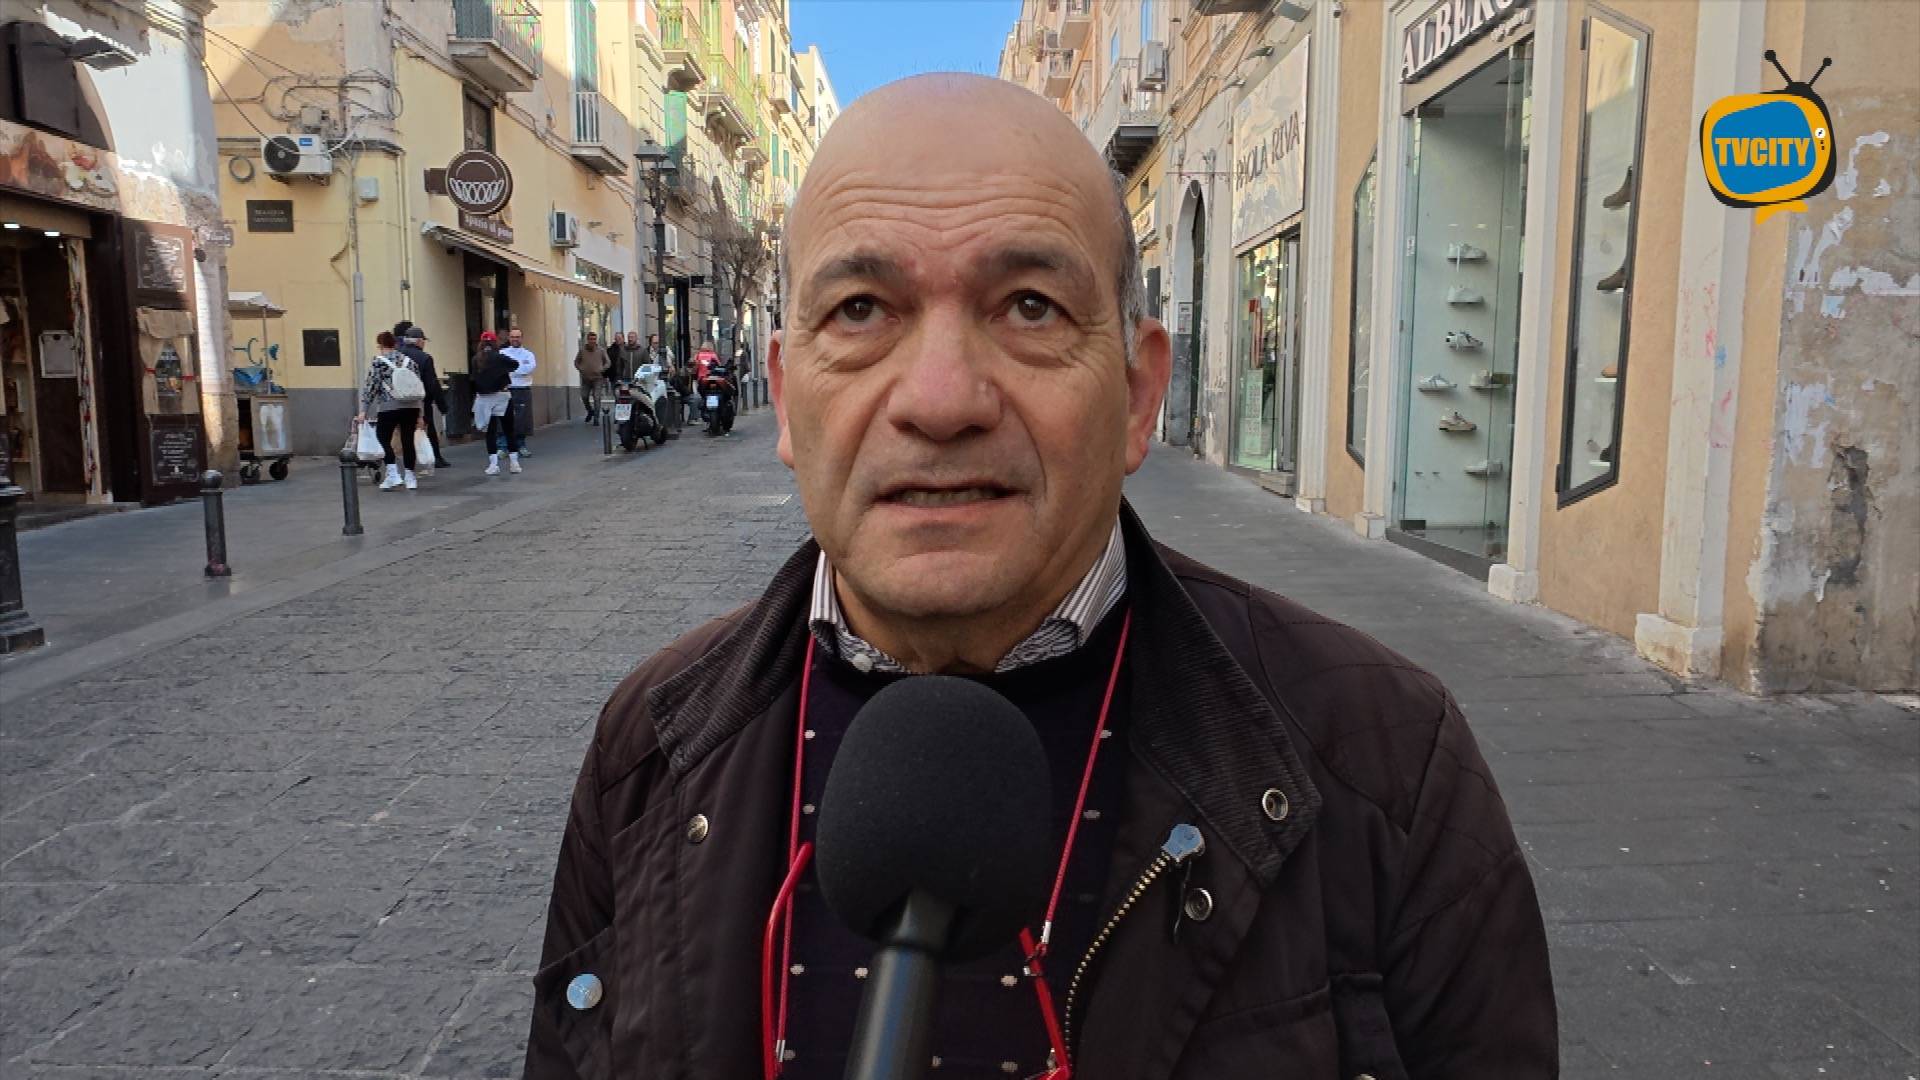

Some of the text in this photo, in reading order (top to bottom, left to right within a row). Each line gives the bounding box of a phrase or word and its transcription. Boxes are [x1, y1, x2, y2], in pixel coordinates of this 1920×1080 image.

[1399, 0, 1513, 81] ALBER
[1235, 110, 1301, 193] PAOLA RIVA
